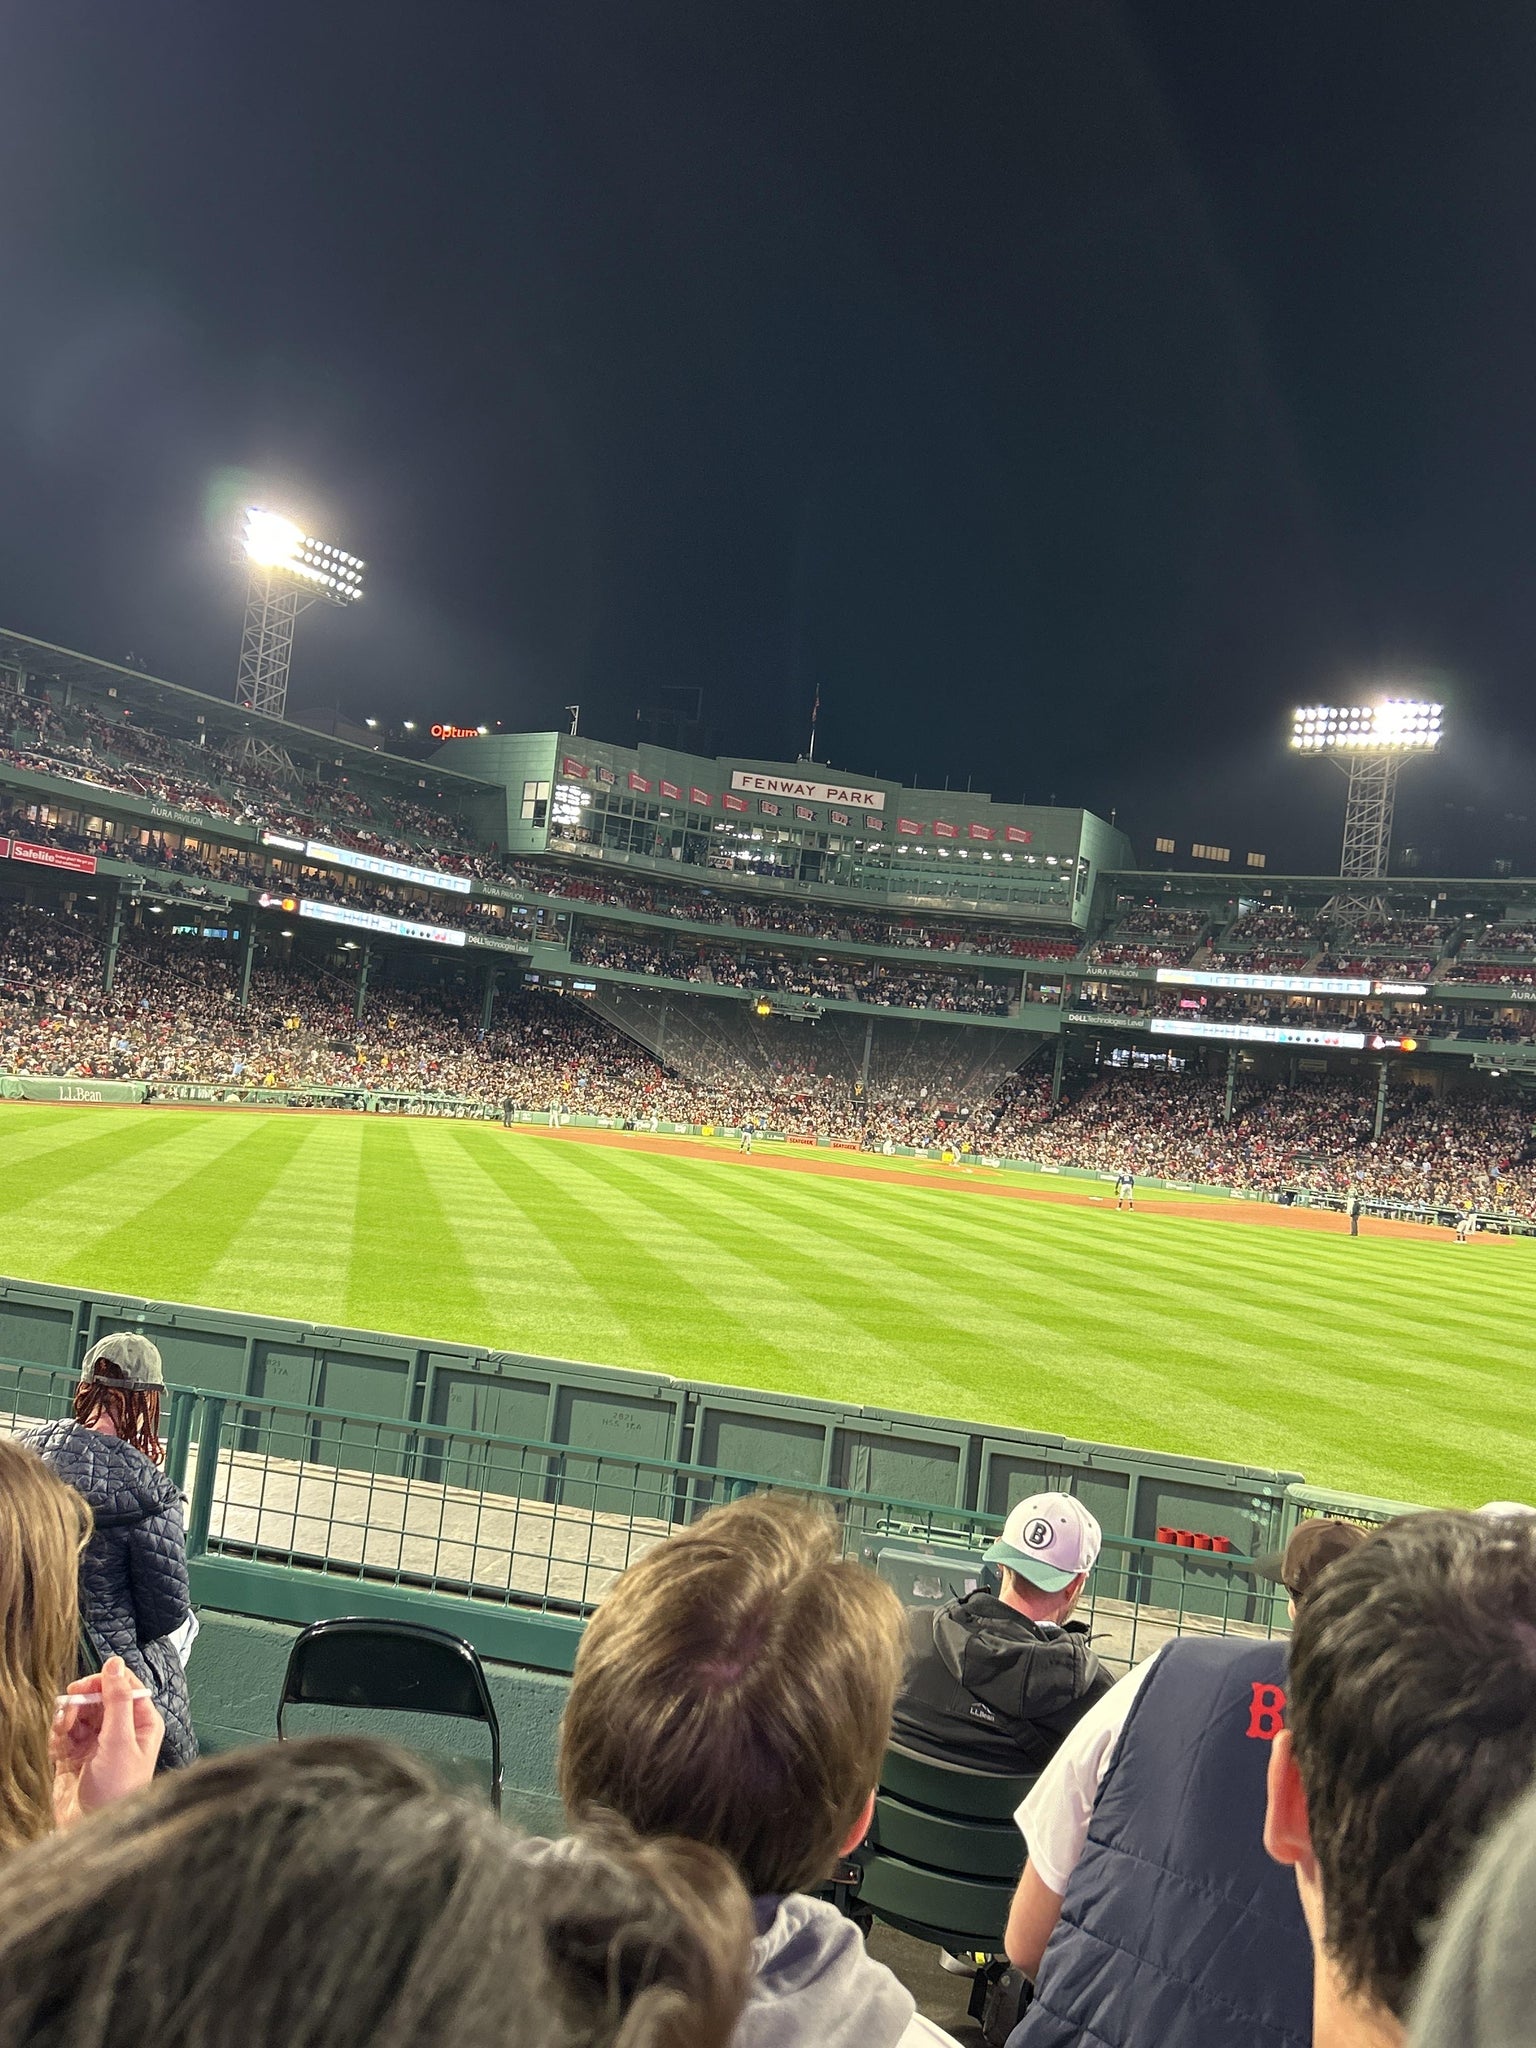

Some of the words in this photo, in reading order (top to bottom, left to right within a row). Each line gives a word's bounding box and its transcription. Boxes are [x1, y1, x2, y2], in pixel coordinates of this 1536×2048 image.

[430, 724, 478, 740] Optum
[742, 776, 816, 796] FENWAY
[826, 788, 875, 806] PARK
[173, 811, 203, 827] PAVILION
[14, 846, 55, 863] Safelite
[468, 935, 485, 945] DELL
[1108, 968, 1139, 977] PAVILION
[1068, 1014, 1088, 1022] DELL
[1087, 1015, 1127, 1026] Technologies
[1127, 1018, 1144, 1027] Level
[59, 1086, 102, 1102] L.L.Bean
[1029, 1521, 1047, 1545] B
[1245, 1681, 1287, 1740] B
